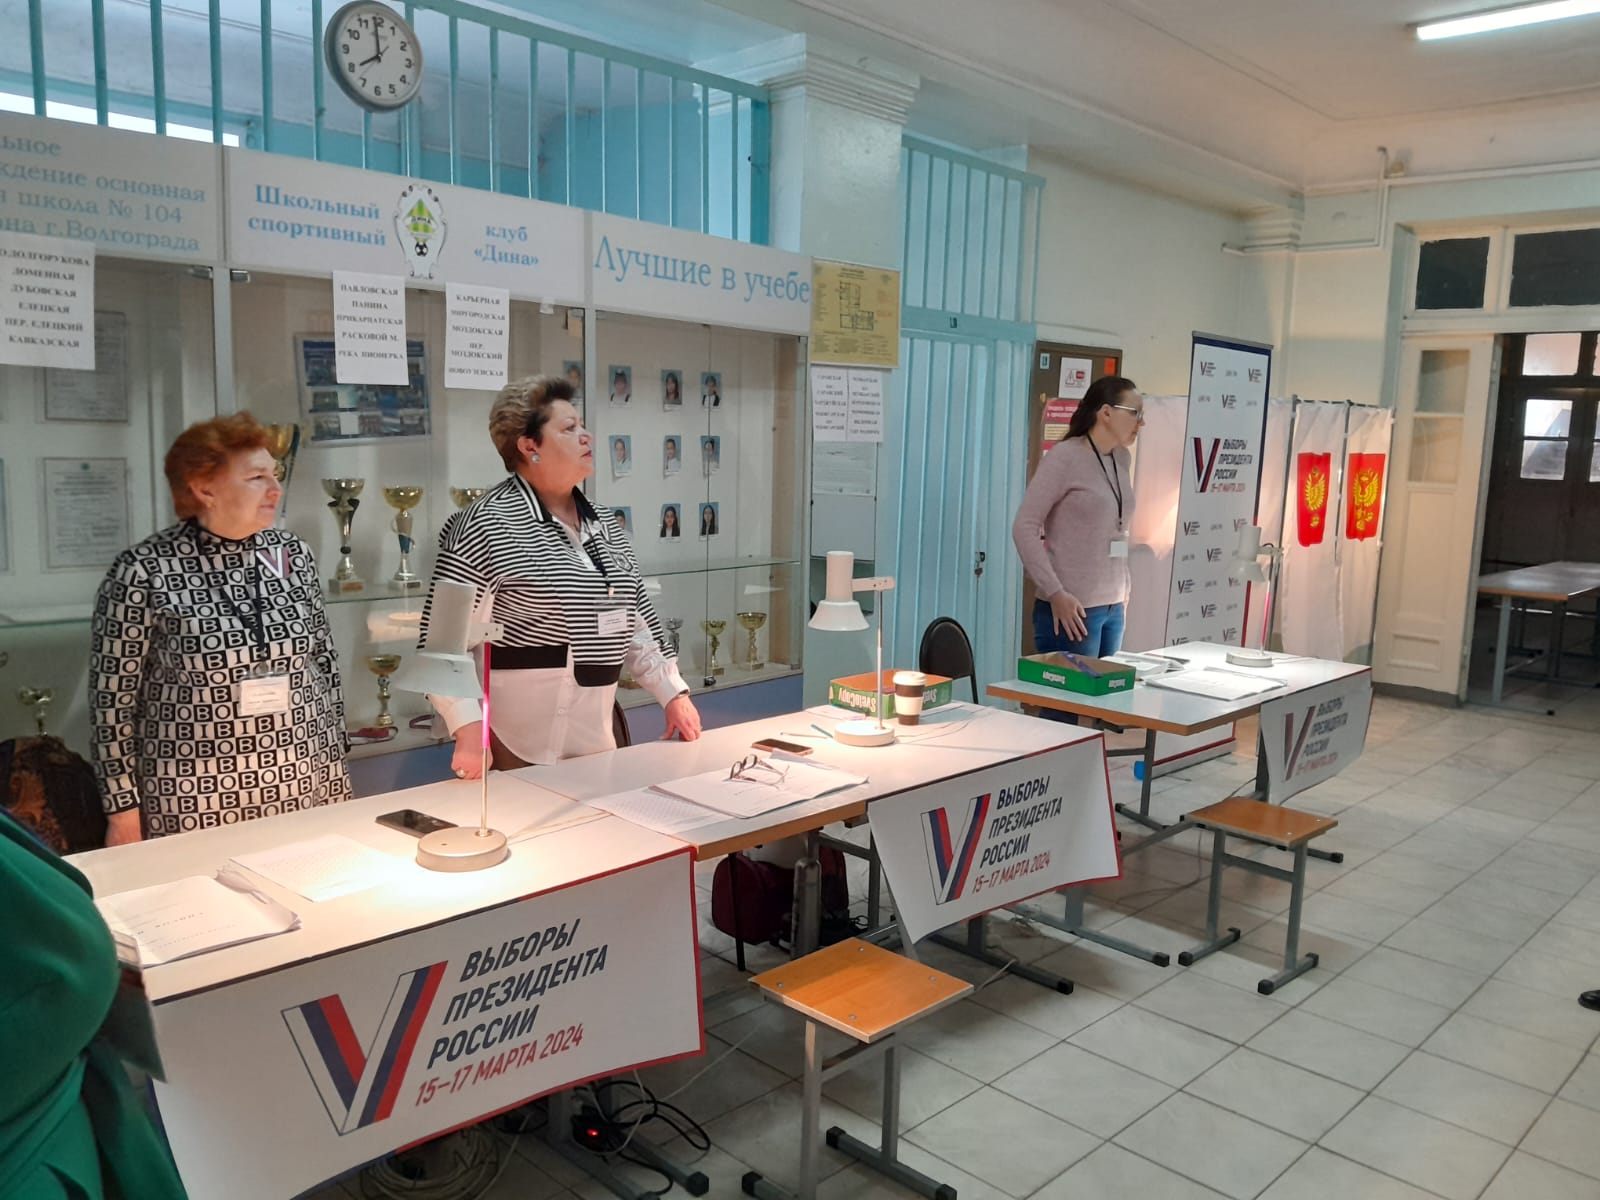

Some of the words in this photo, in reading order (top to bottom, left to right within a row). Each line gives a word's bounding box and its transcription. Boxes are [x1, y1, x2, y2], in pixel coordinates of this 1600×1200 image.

[357, 18, 369, 29] 11
[390, 26, 396, 36] 1
[347, 28, 361, 41] 10
[342, 43, 350, 55] 9
[400, 41, 407, 52] 2
[348, 62, 356, 73] 8
[405, 58, 412, 69] 3
[360, 77, 367, 88] 7
[389, 84, 396, 95] 5
[400, 75, 407, 84] 4
[374, 85, 382, 96] 6
[0, 134, 62, 156] ьное
[96, 176, 206, 202] основная
[18, 192, 99, 216] школа
[108, 199, 133, 218] №
[144, 204, 183, 225] 104
[255, 184, 380, 220] Школьный
[248, 215, 387, 247] спортивный
[485, 224, 528, 242] клуб
[474, 243, 540, 267] «Дина»
[594, 235, 712, 287] Лучшие
[721, 267, 736, 291] в
[743, 270, 811, 303] учебе
[340, 284, 399, 296] ПАВЛОВСКАЯ
[352, 300, 388, 310] ПАНИНА
[8, 335, 80, 348] КАВКАЗСКАЯ
[342, 331, 388, 342] РАСКОВОЙ
[838, 687, 876, 713] SvetoCopy
[996, 775, 1051, 810] ВЫБОРЫ
[988, 797, 1063, 839] ПРЕЗИДЕНТА
[980, 833, 1031, 869] РОССИИ
[999, 858, 1029, 885] МАРТА
[1030, 850, 1051, 874] 2024
[459, 918, 581, 983] ВЫБОРЫ
[442, 944, 609, 1026] ПРЕЗИДЕНТА
[427, 1004, 541, 1070] РОССИИ
[472, 1039, 538, 1086] МАРТА
[539, 1022, 584, 1060] 2024
